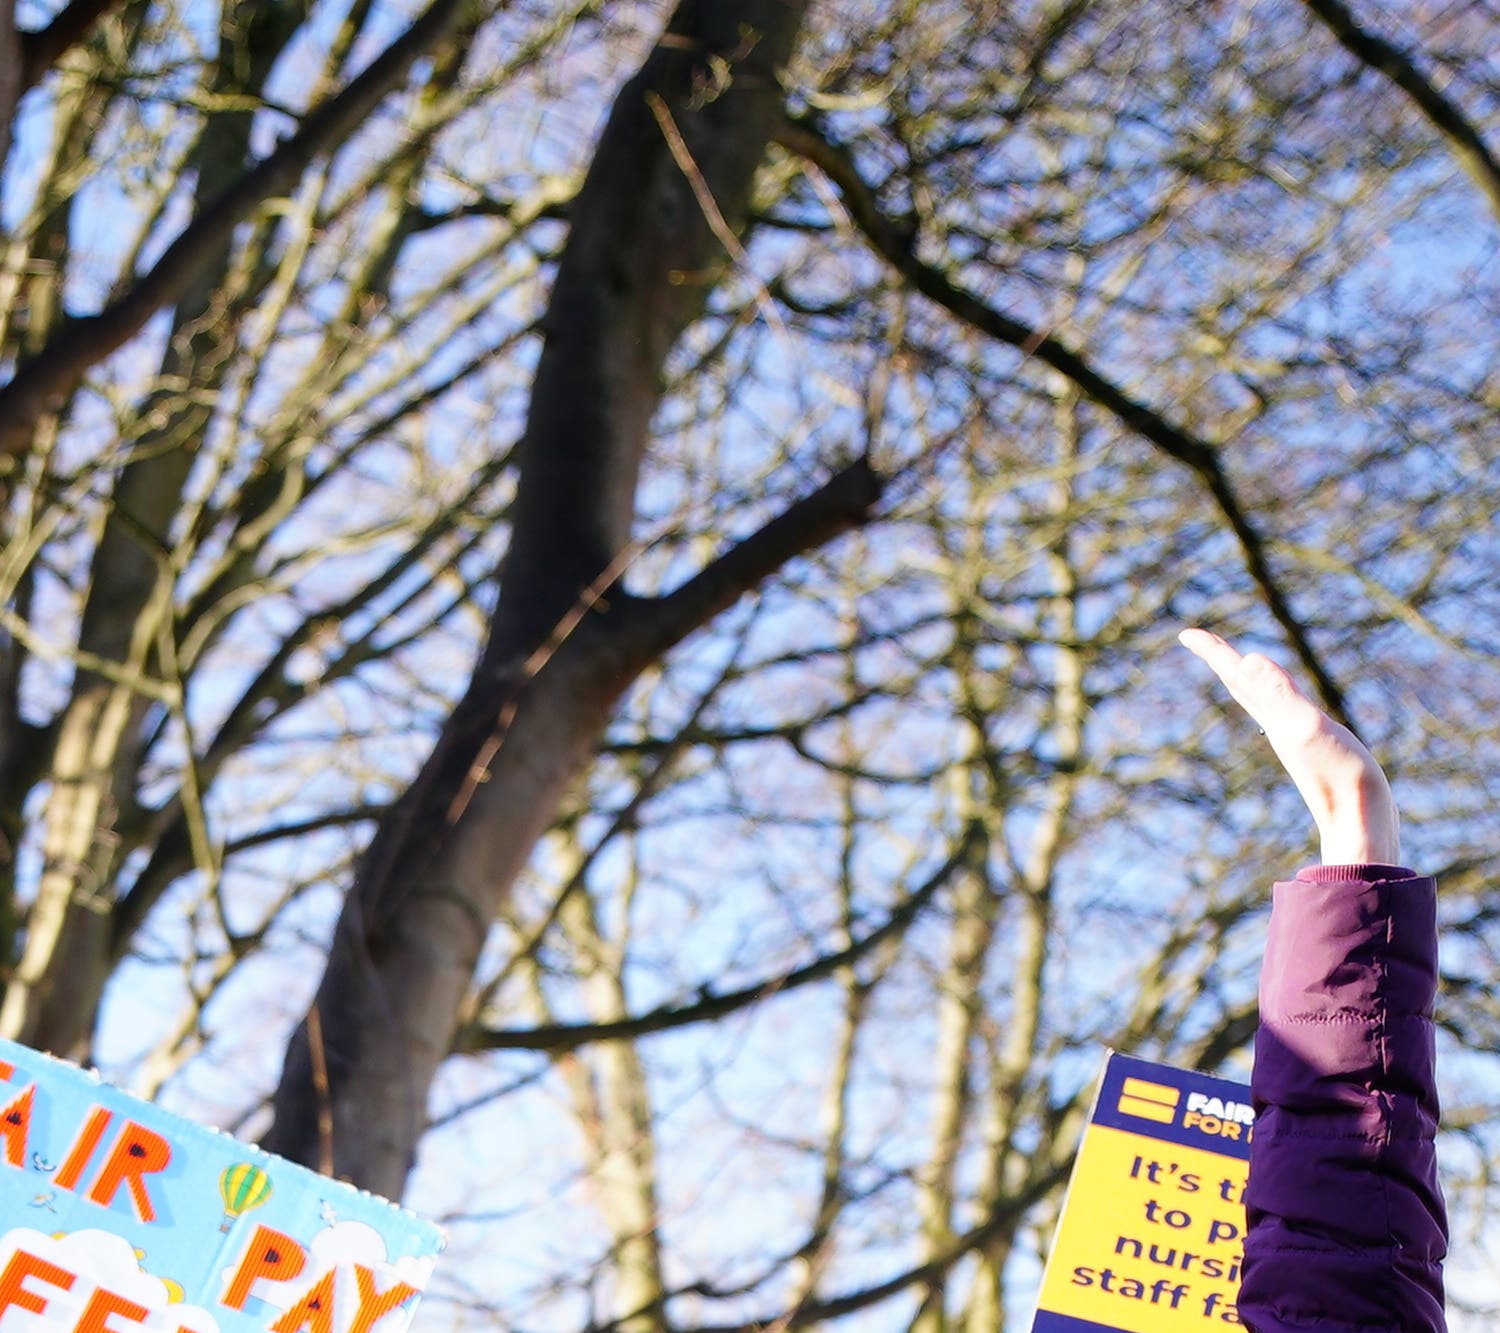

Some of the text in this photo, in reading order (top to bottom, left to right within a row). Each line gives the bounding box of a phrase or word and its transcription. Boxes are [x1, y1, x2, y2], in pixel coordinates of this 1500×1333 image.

[1183, 1111, 1241, 1140] FOR
[1187, 1092, 1256, 1125] FAIR
[1129, 1155, 1201, 1192] It's
[1145, 1199, 1247, 1245] to p
[1071, 1264, 1190, 1309] staff
